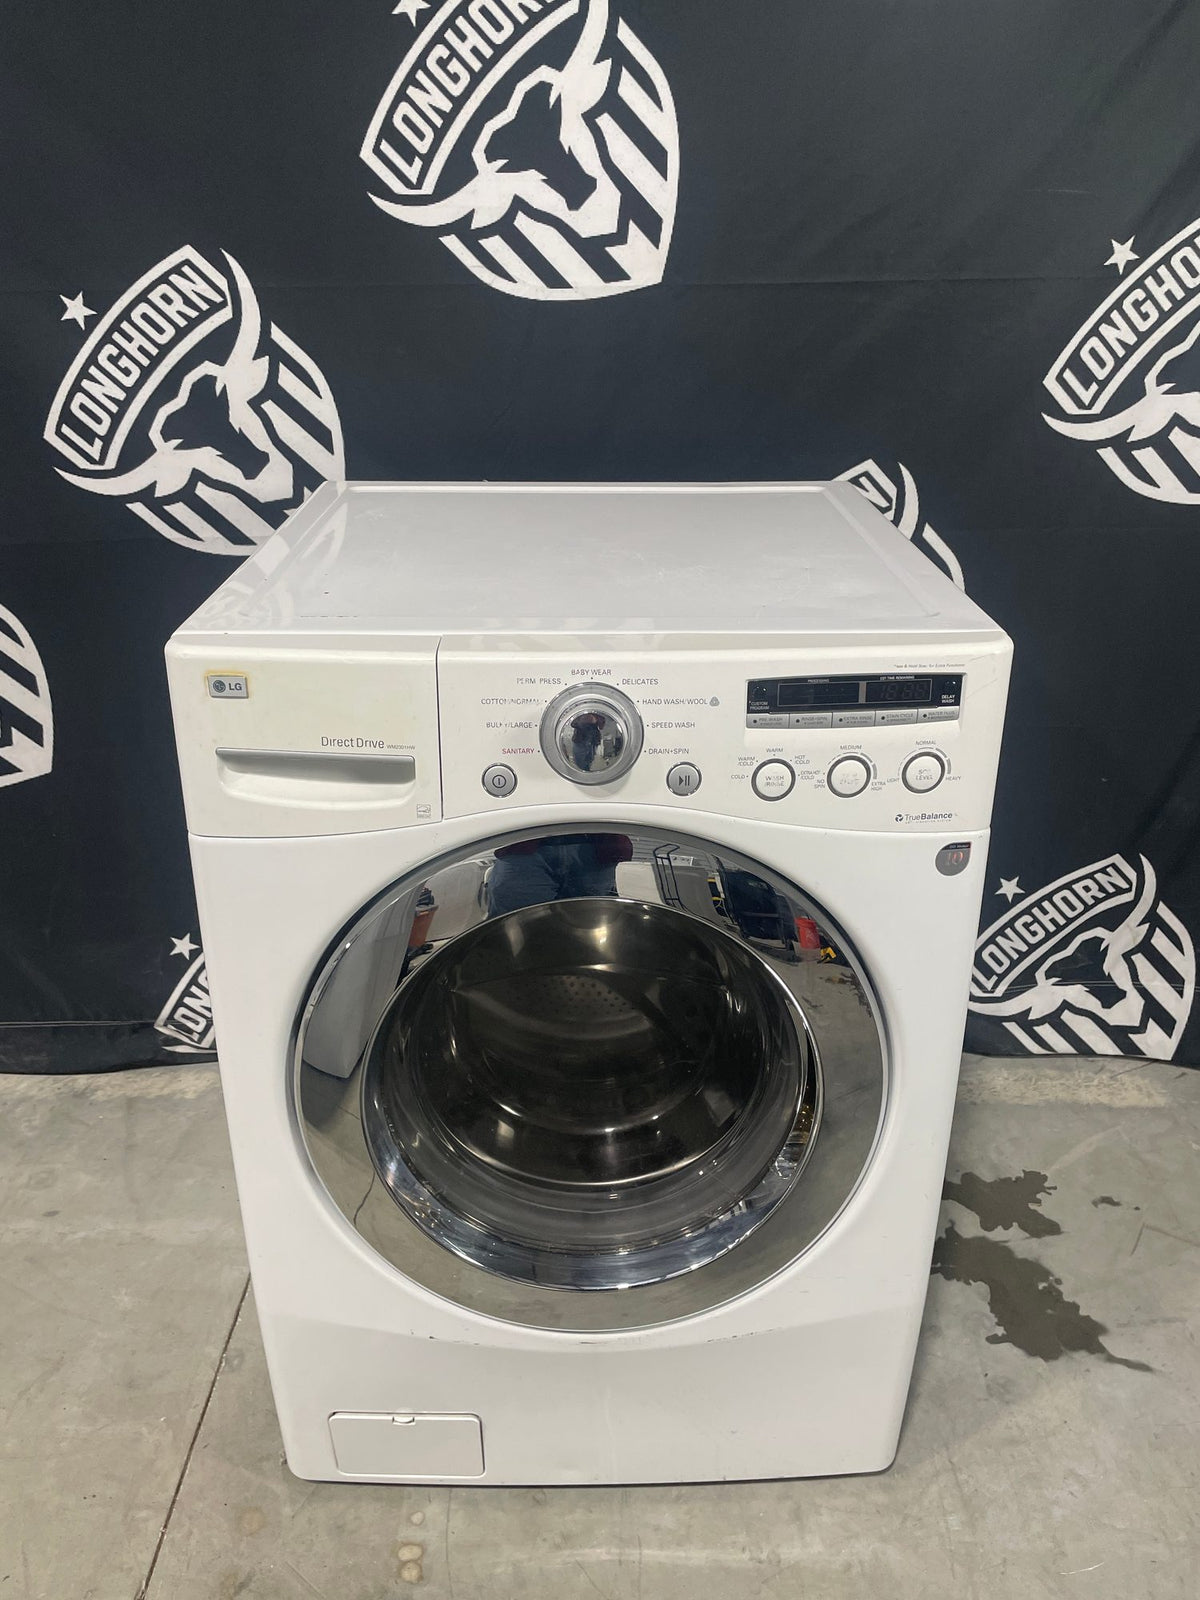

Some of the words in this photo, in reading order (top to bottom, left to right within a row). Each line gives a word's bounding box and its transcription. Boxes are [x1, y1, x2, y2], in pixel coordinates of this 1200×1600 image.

[60, 264, 225, 462] LONGHORN
[228, 682, 243, 692] LG
[321, 736, 354, 748] Direct
[356, 737, 385, 749] Drive
[904, 812, 953, 821] TrueBalance
[980, 865, 1131, 991] LONGHORN
[167, 968, 211, 1042] LON
